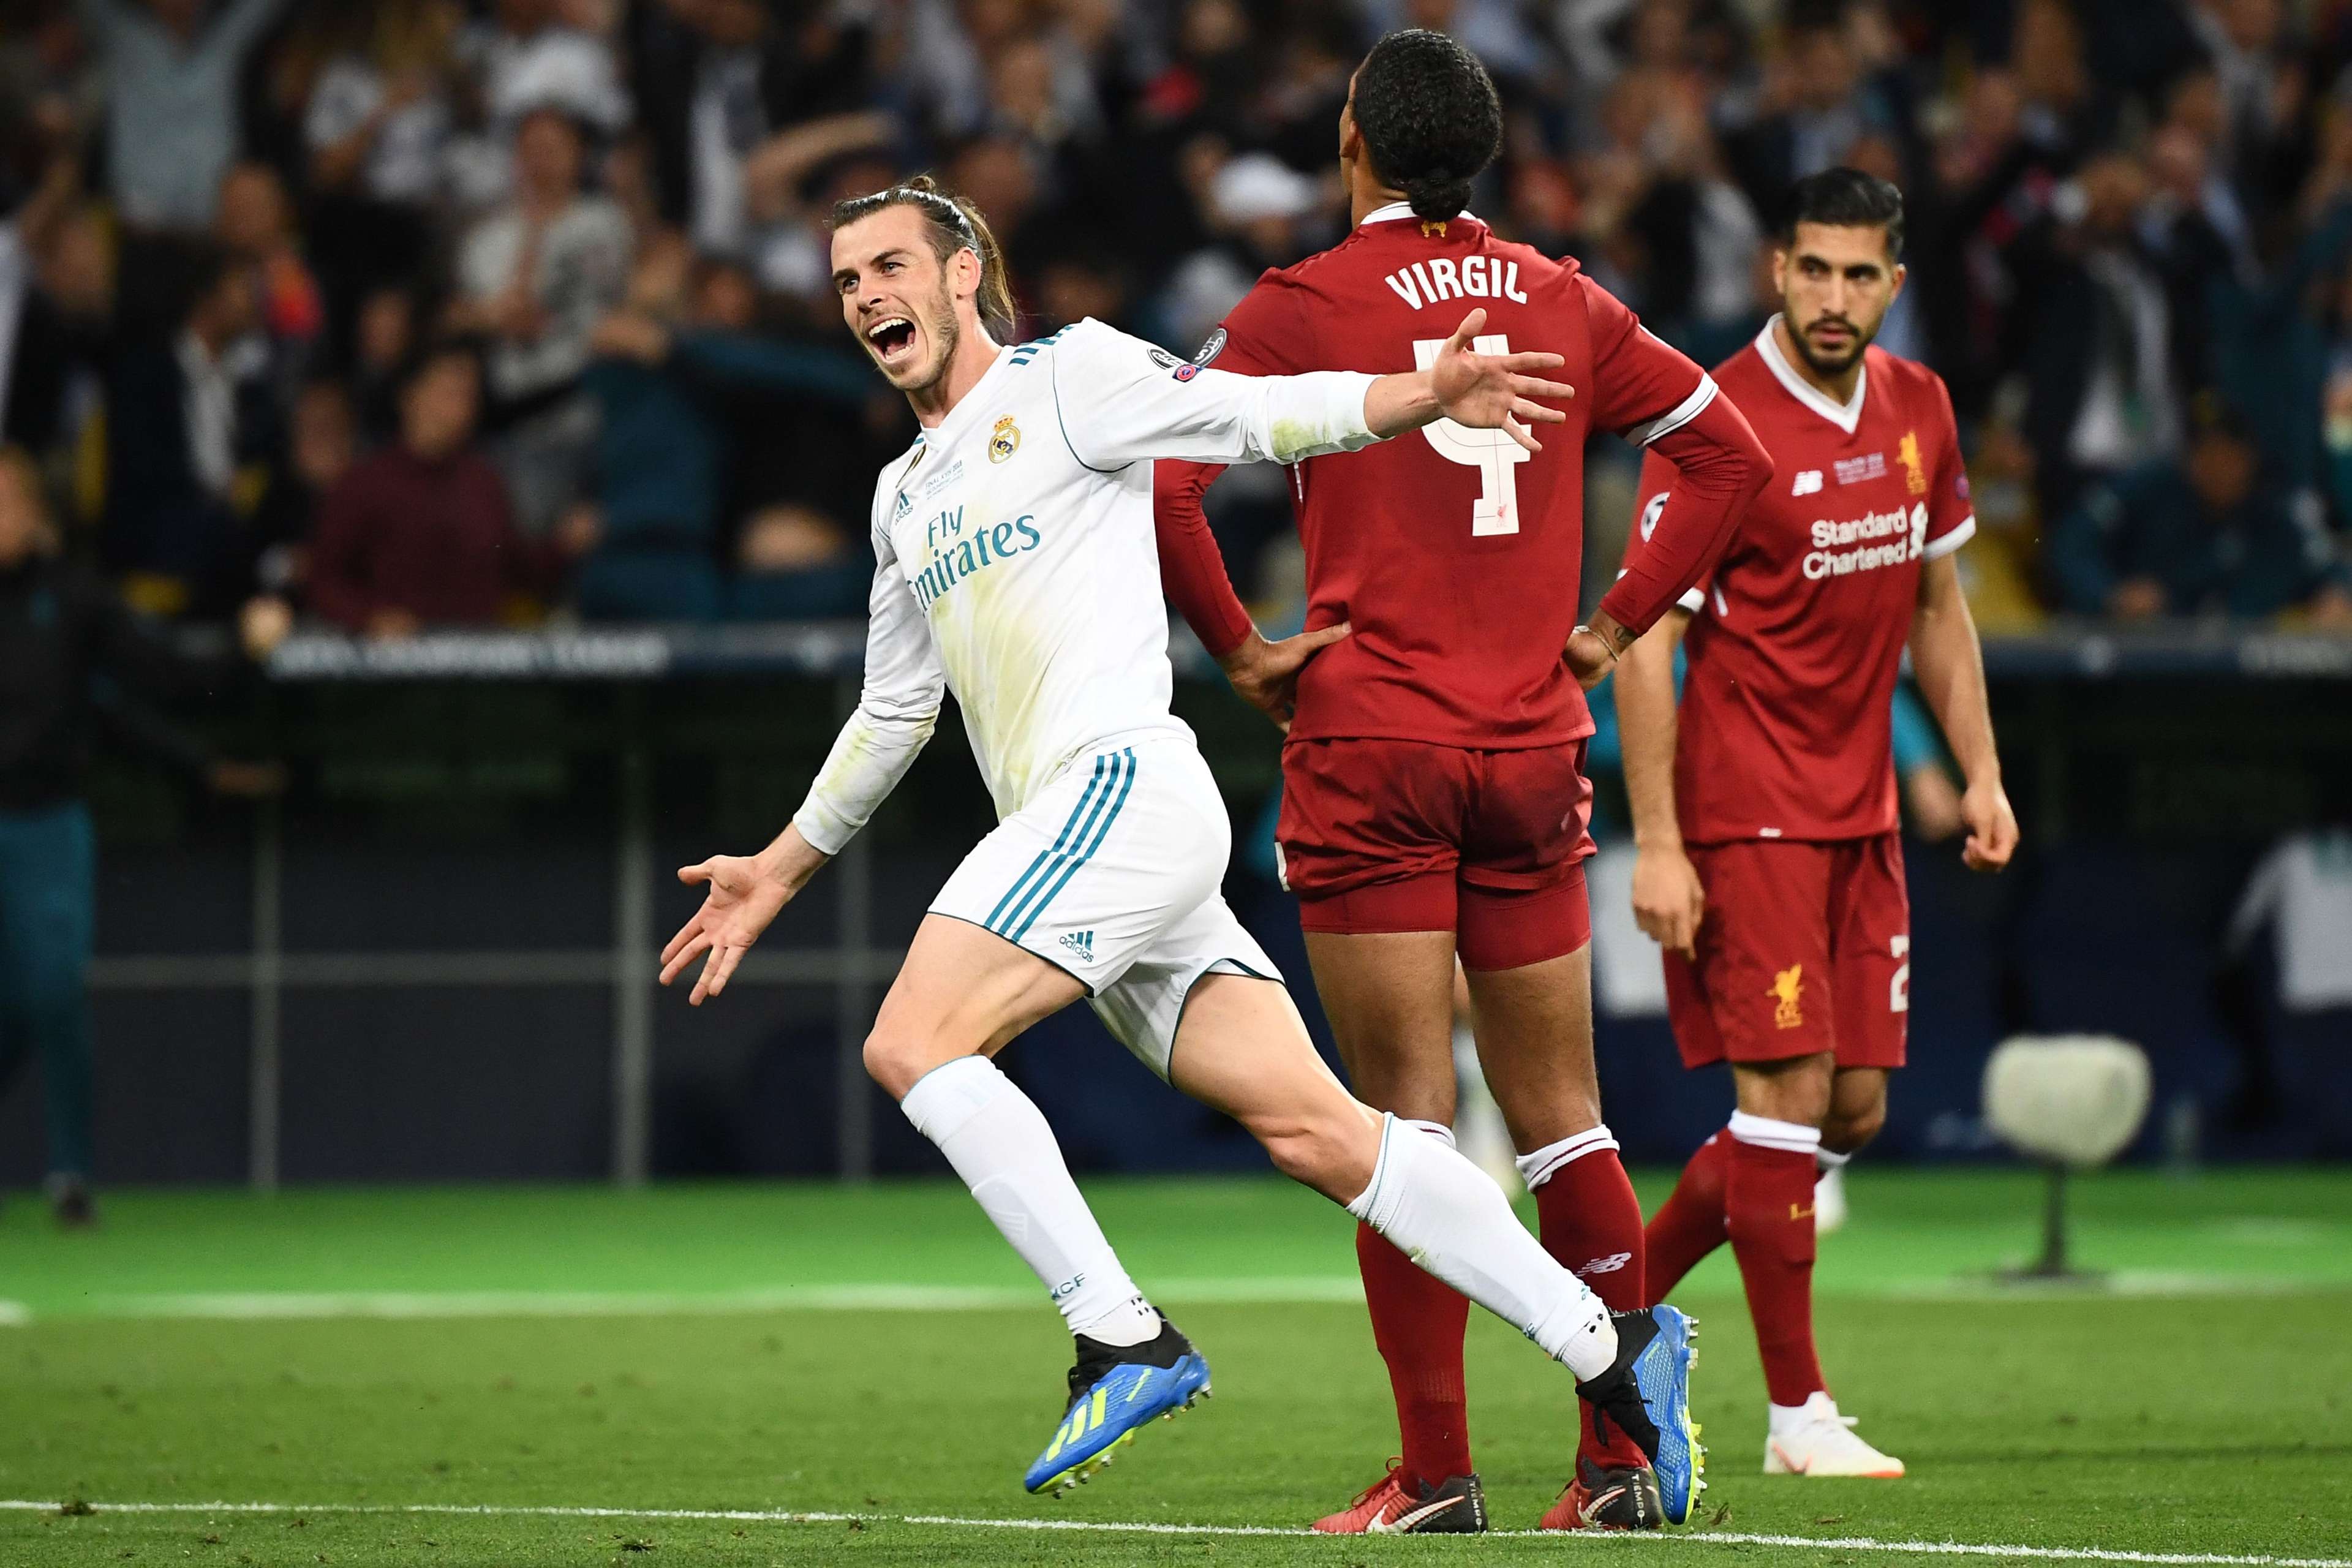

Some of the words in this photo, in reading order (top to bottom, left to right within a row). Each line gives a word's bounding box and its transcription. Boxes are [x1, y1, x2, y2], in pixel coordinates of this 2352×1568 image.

[1384, 255, 1528, 310] VIRGIL
[1412, 334, 1532, 537] 4
[928, 505, 963, 548] Fly
[1811, 505, 1907, 548] Standard
[907, 514, 1041, 619] mirates
[1803, 537, 1907, 579] Chartered
[1058, 936, 1094, 963] adidas
[1468, 1480, 1482, 1526] TIEMPO
[1631, 1473, 1645, 1518] TIEMPO
